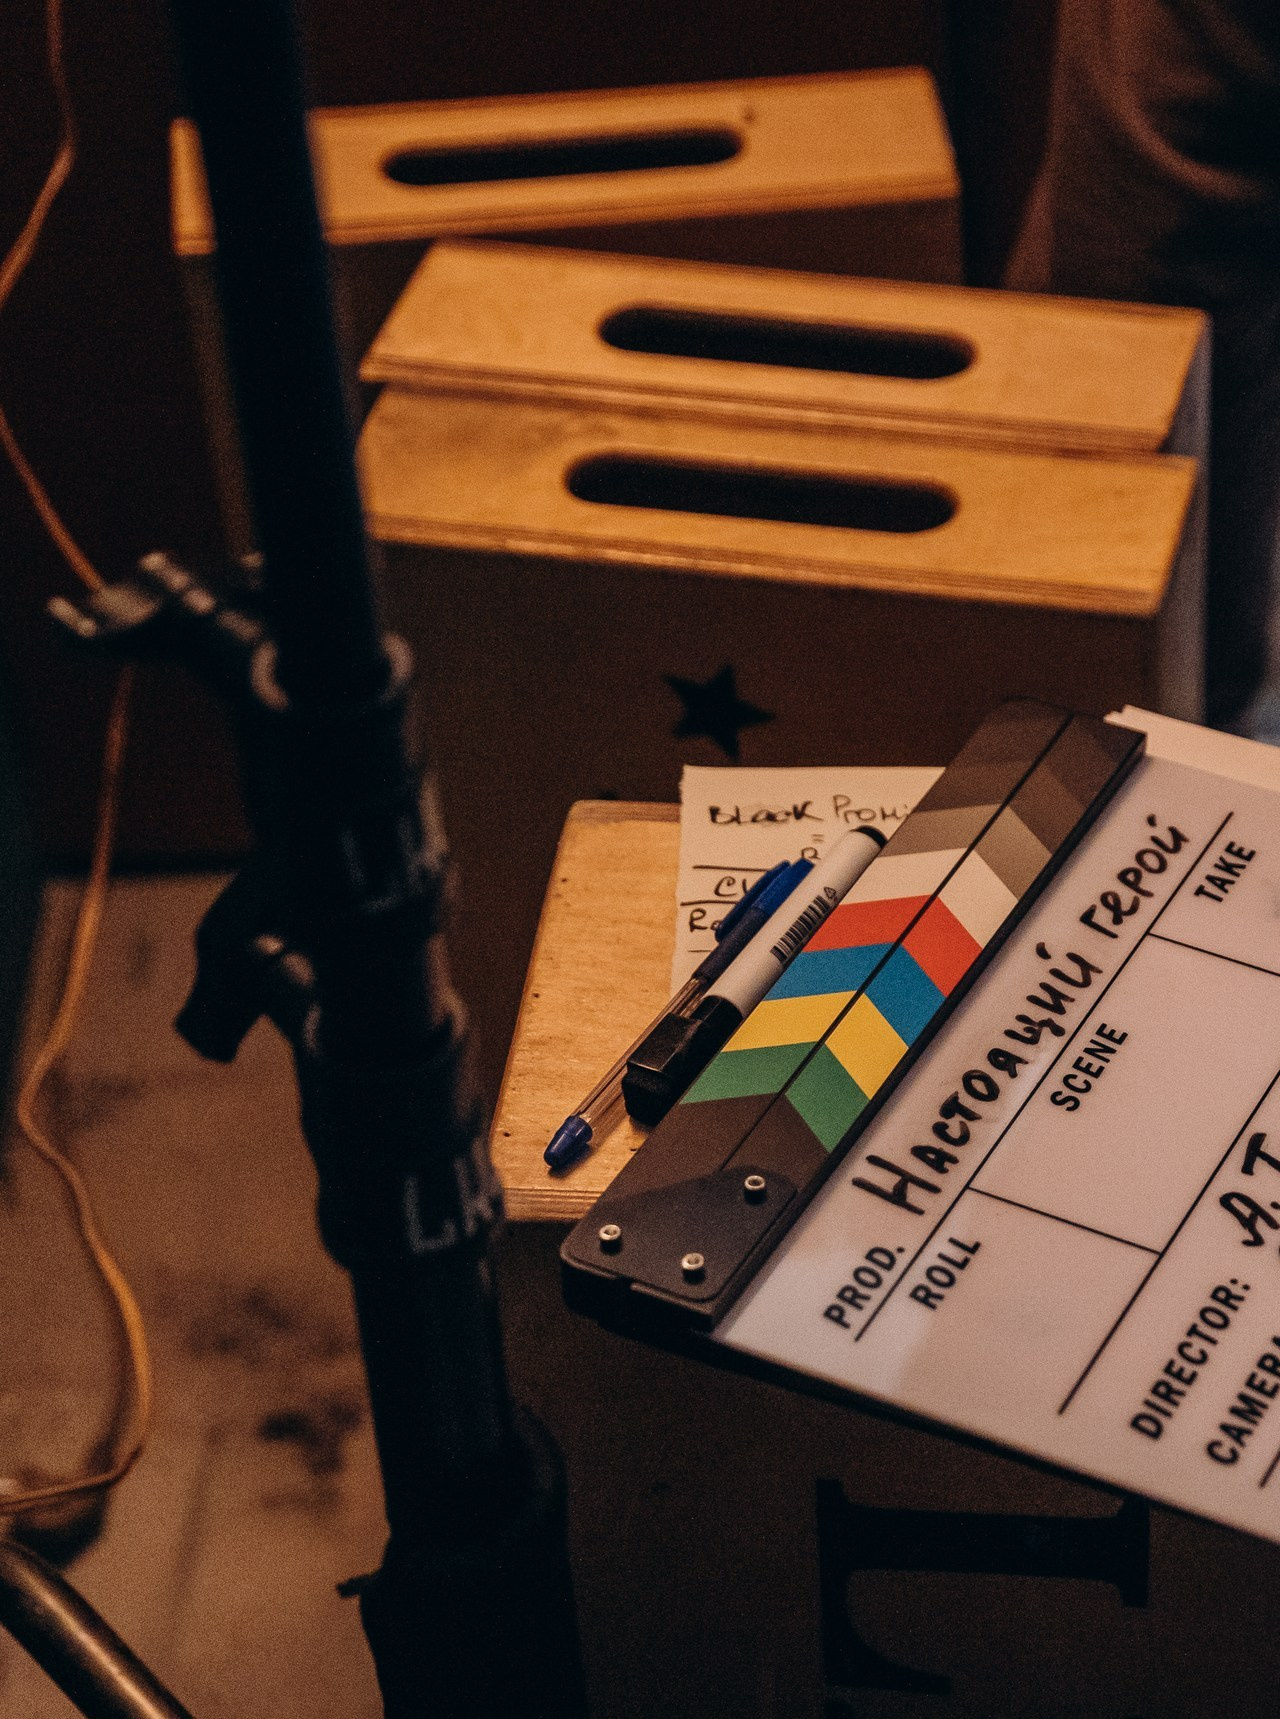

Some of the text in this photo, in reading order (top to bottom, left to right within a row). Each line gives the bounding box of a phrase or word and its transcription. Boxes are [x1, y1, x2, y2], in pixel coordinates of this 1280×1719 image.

[1193, 841, 1256, 903] TAKE
[851, 814, 1189, 1216] Настоящий герой
[1049, 1023, 1128, 1112] SCENE
[823, 1246, 905, 1329] PROD.
[909, 1237, 982, 1310] ROLL
[1129, 1278, 1251, 1441] DIRECTOR:
